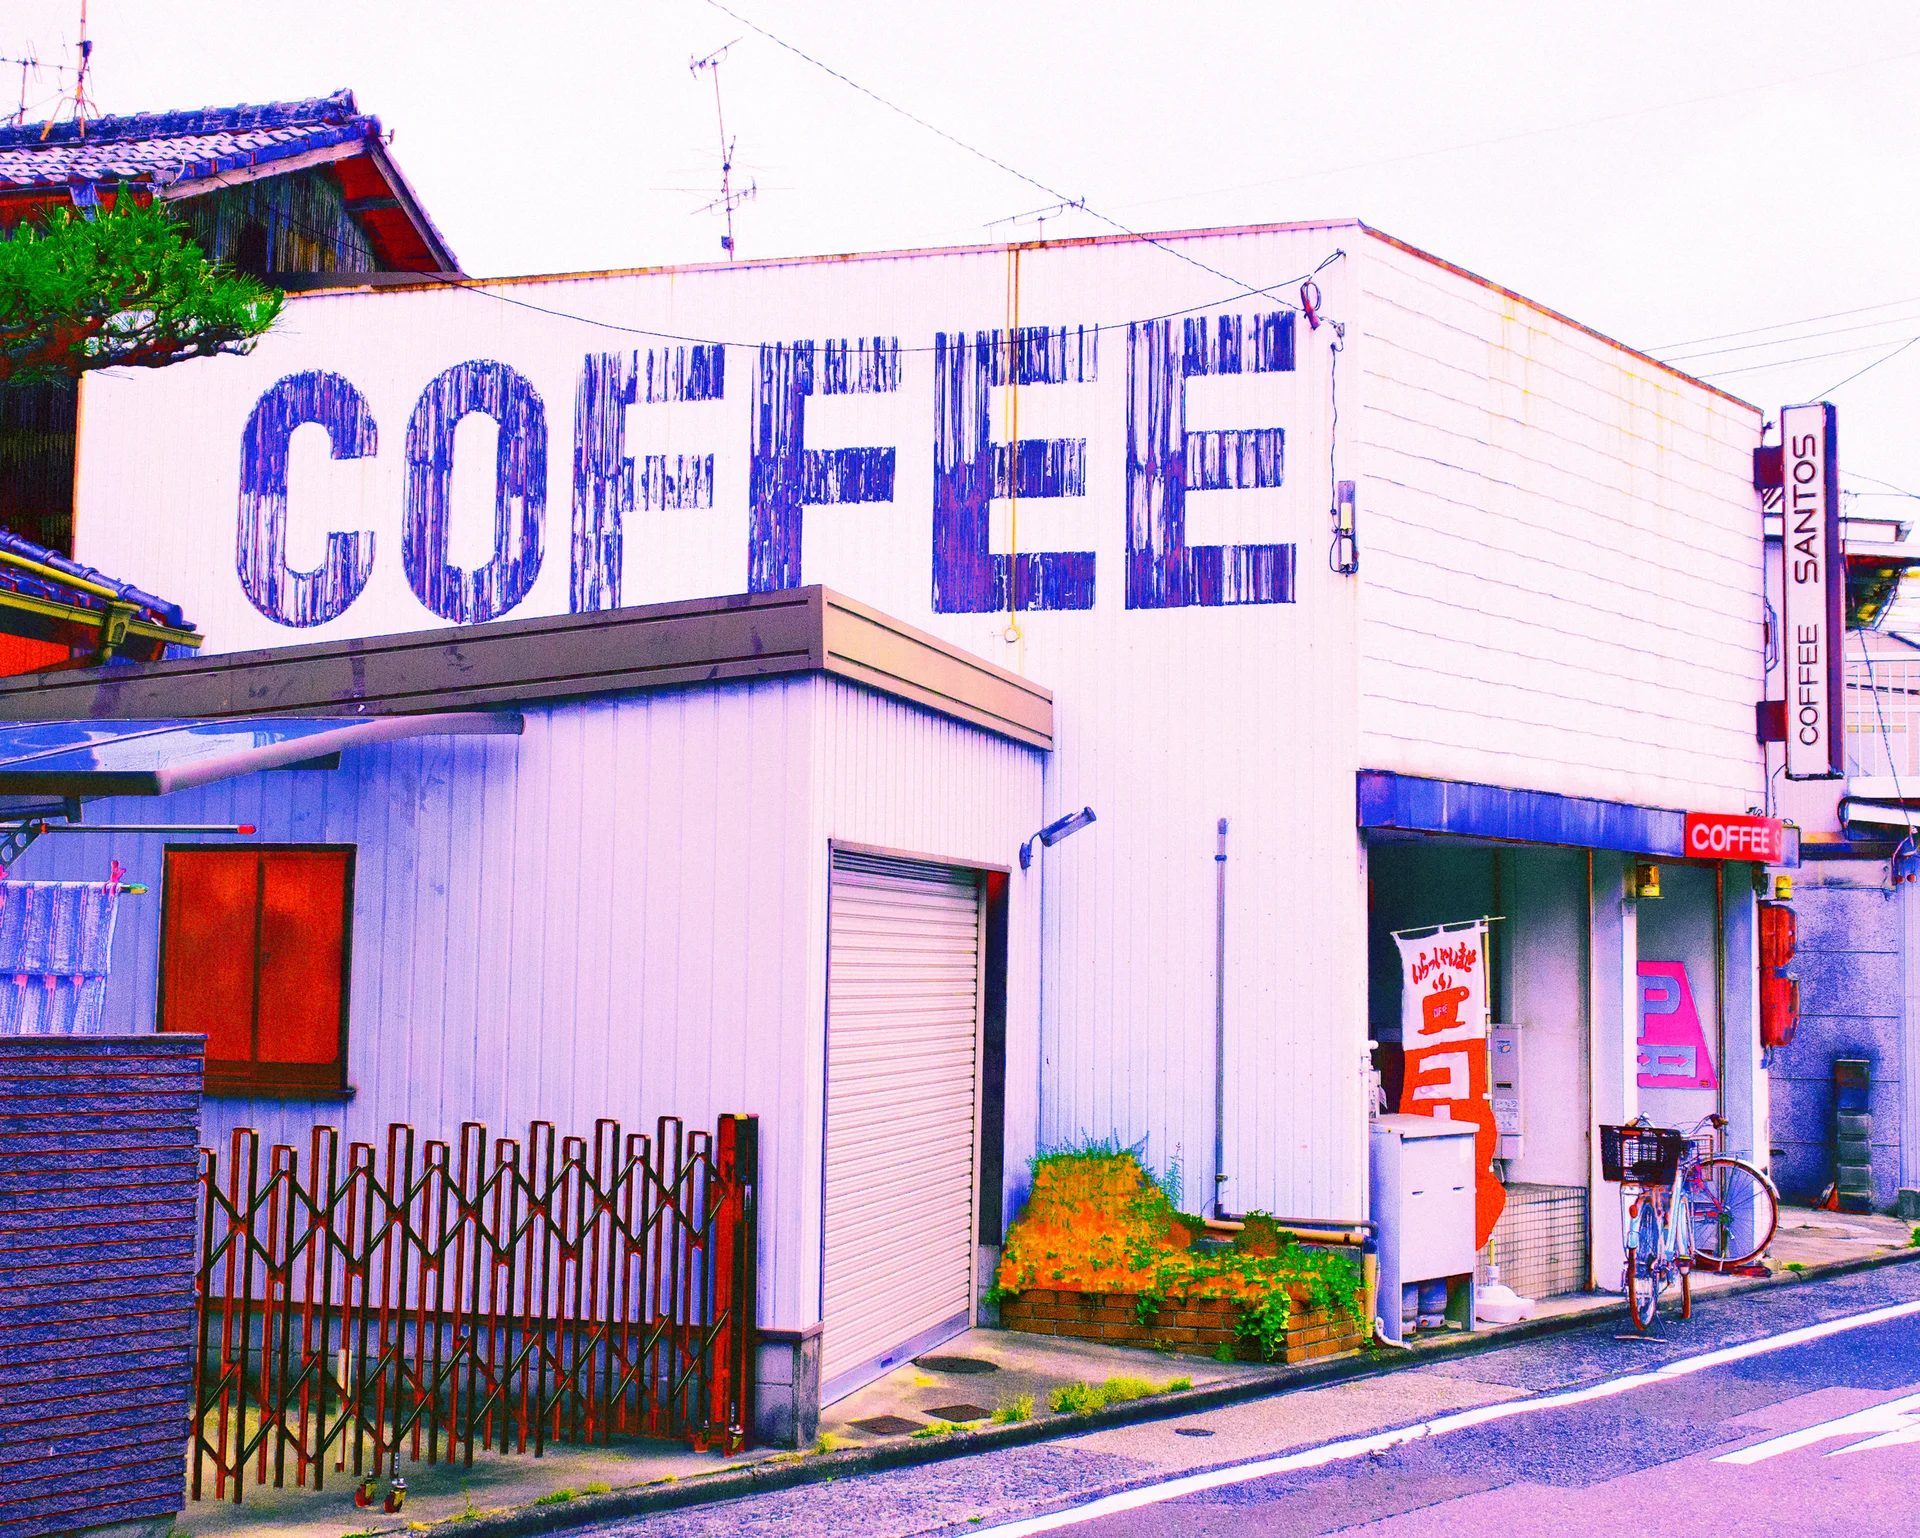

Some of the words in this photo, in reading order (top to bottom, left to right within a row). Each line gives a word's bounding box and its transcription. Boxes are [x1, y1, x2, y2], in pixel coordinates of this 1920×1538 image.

[236, 311, 1297, 628] COFFEE
[1793, 434, 1819, 584] SANTOS
[1798, 624, 1819, 745] COFFEE
[1691, 823, 1770, 854] COFFEE
[1411, 941, 1477, 985] いらっしゃいませ
